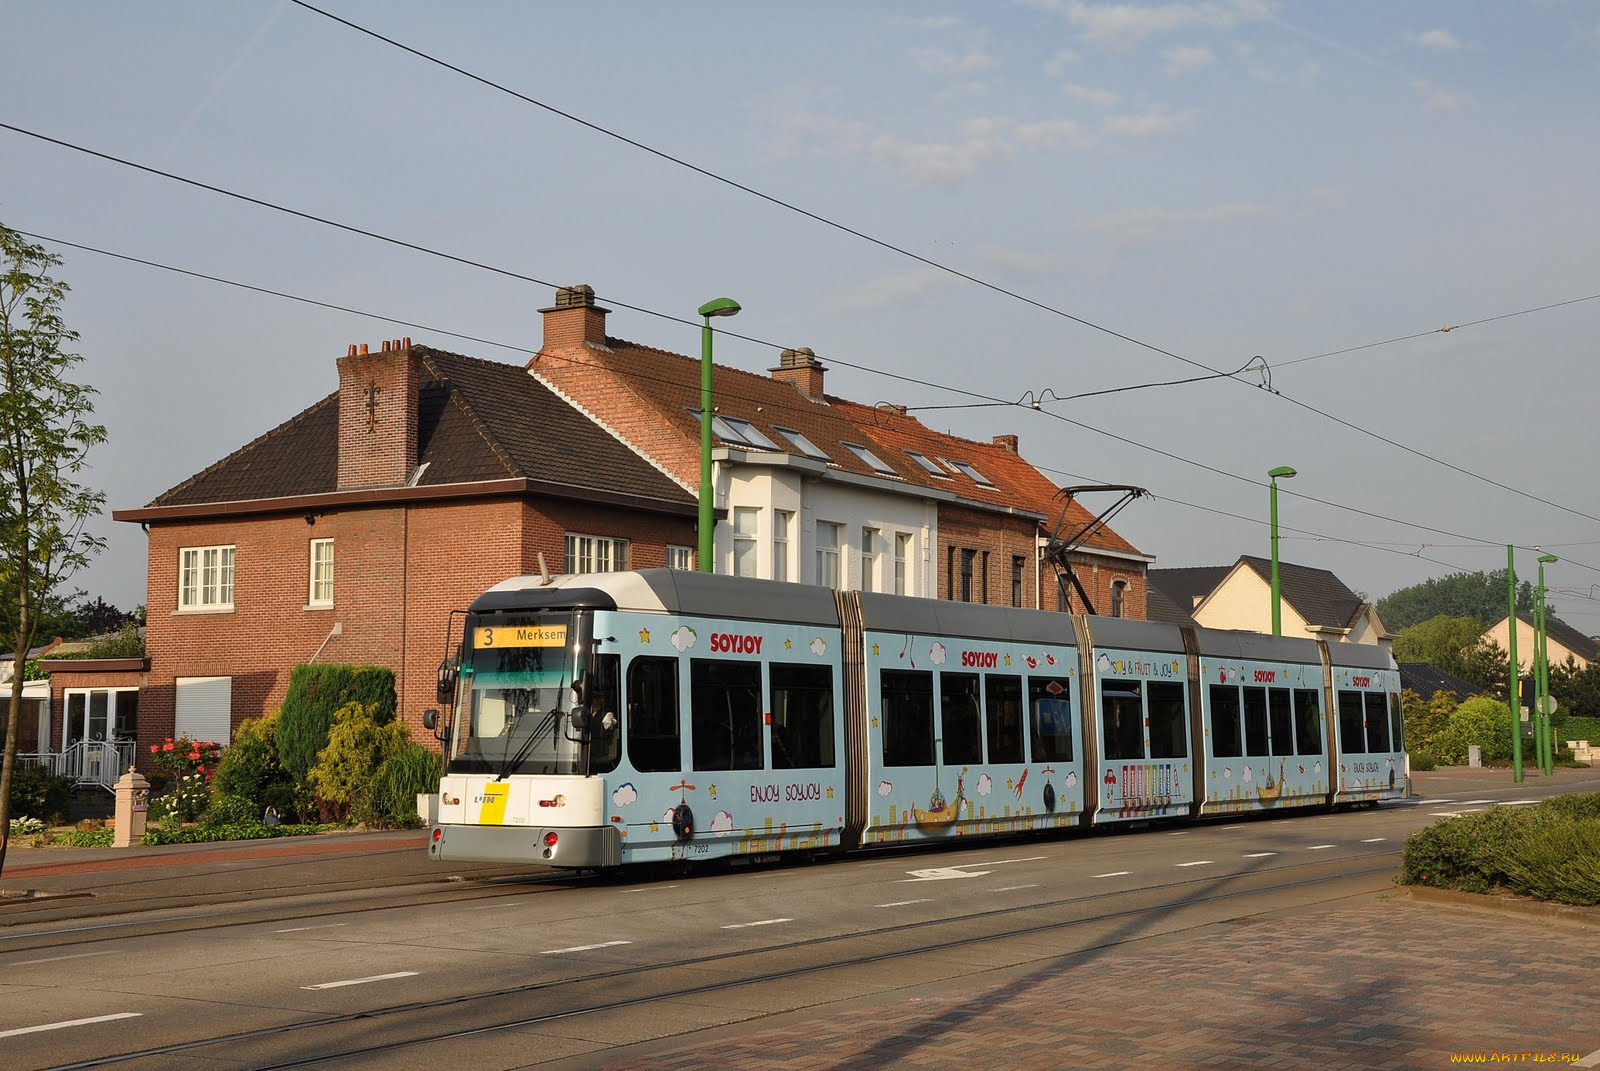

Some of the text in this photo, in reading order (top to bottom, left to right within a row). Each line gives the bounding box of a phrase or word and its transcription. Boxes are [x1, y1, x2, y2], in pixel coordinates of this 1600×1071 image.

[483, 627, 566, 646] 3 Merksem
[710, 632, 763, 655] SOYJOY
[961, 650, 998, 668] SOYJOY
[1134, 661, 1151, 676] FRUIT
[1254, 670, 1276, 684] SOYJOY
[1352, 676, 1370, 688] SOYJOY
[750, 783, 821, 803] ENJOY SOYJOY
[694, 844, 709, 854] 7202
